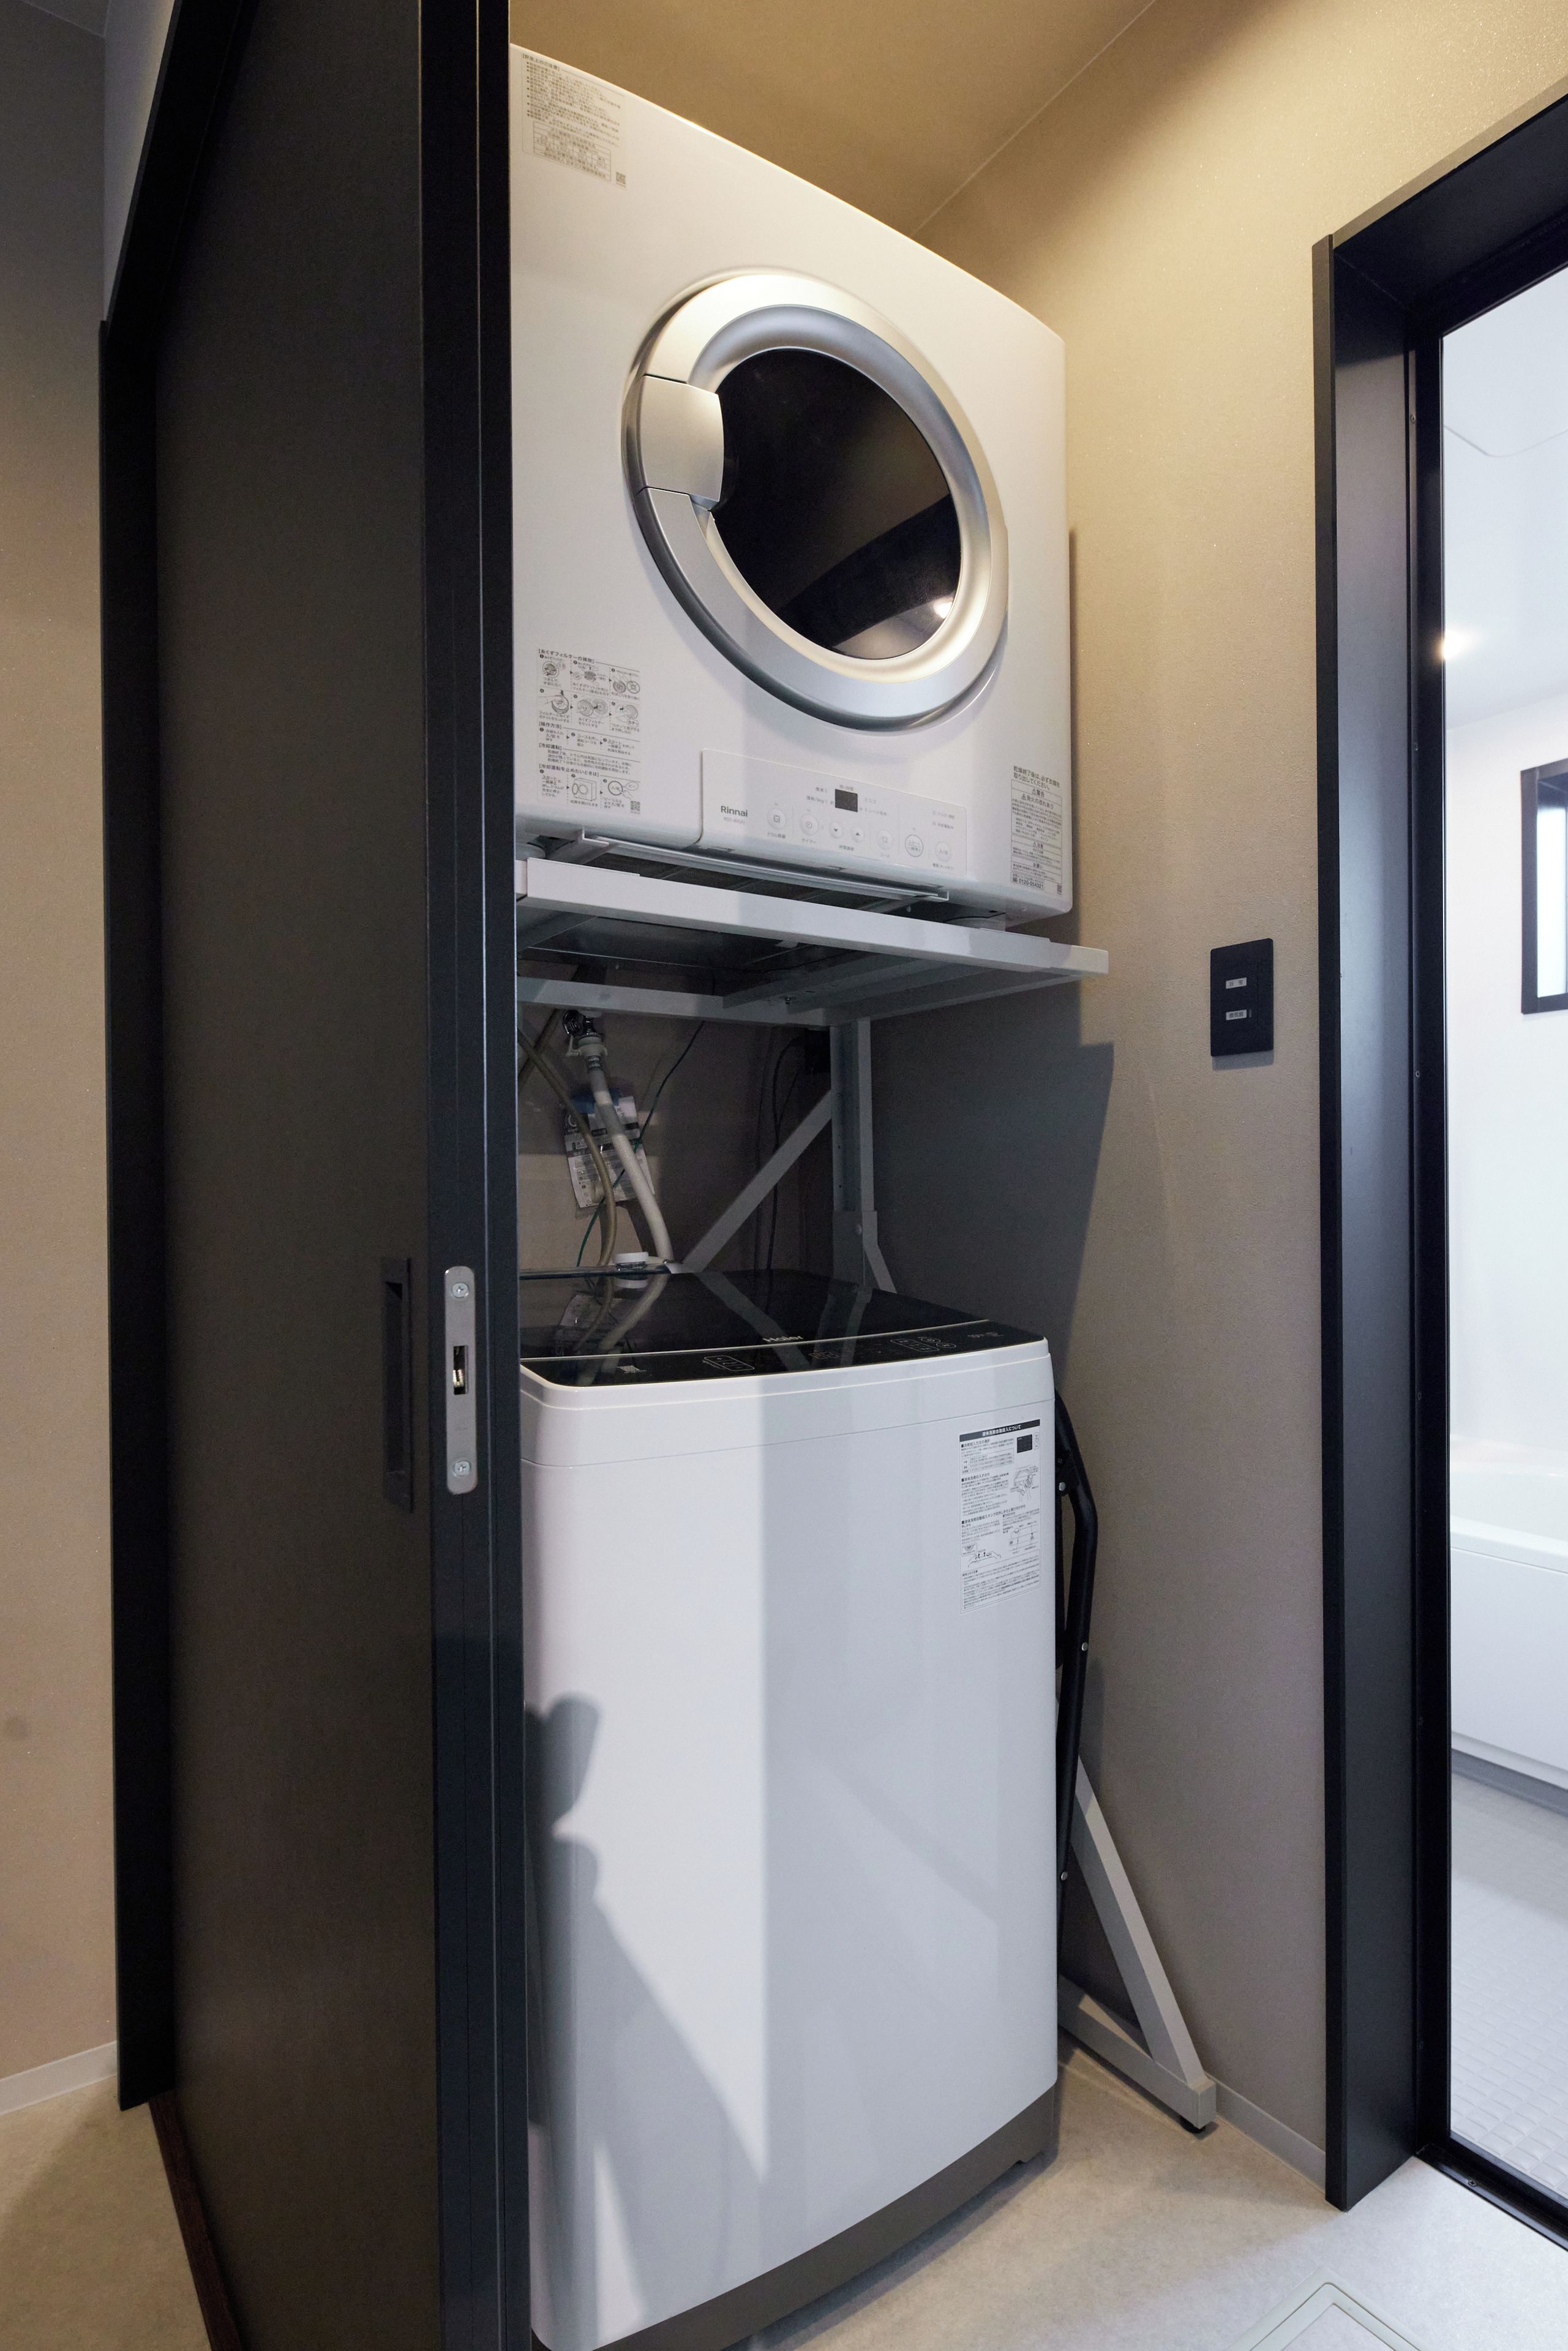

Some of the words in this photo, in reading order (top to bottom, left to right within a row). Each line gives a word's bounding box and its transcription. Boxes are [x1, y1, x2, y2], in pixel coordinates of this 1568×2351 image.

[539, 763, 599, 776] [冷却運転を止めたいときは]
[721, 806, 748, 817] Rinnai
